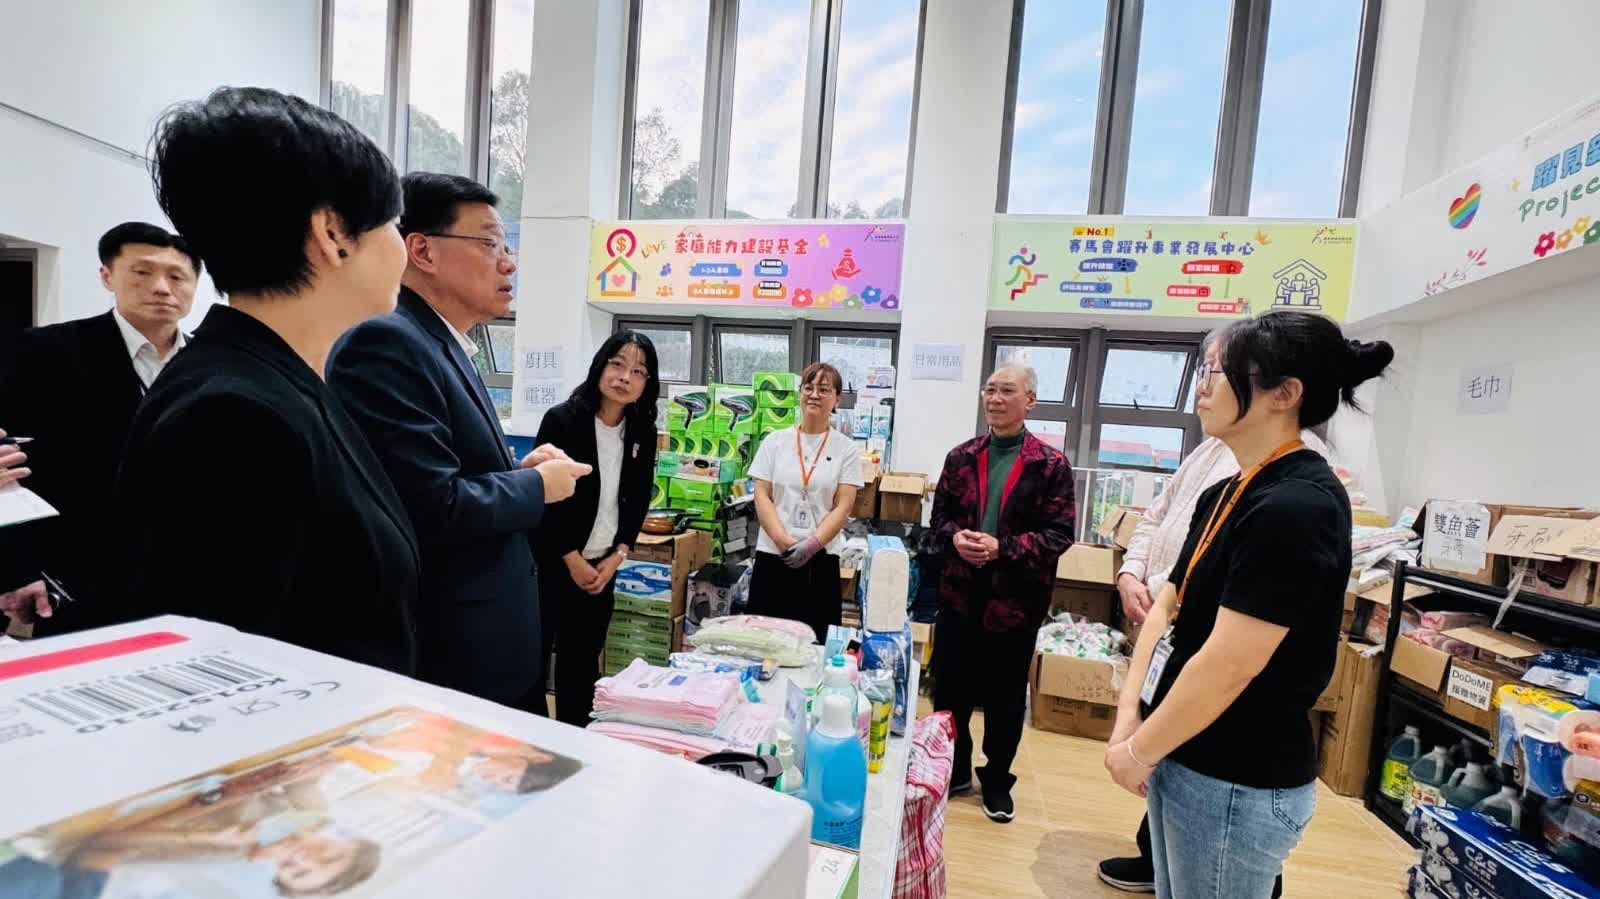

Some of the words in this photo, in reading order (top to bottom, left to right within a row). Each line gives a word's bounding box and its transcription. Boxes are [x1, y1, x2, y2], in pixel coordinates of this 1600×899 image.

[1087, 227, 1109, 236] No.1
[674, 231, 809, 255] 家庭能力建設基金
[525, 351, 557, 369] 廚具
[914, 353, 961, 369] 日常用品
[1467, 375, 1502, 399] 毛巾
[1464, 846, 1498, 876] C&S
